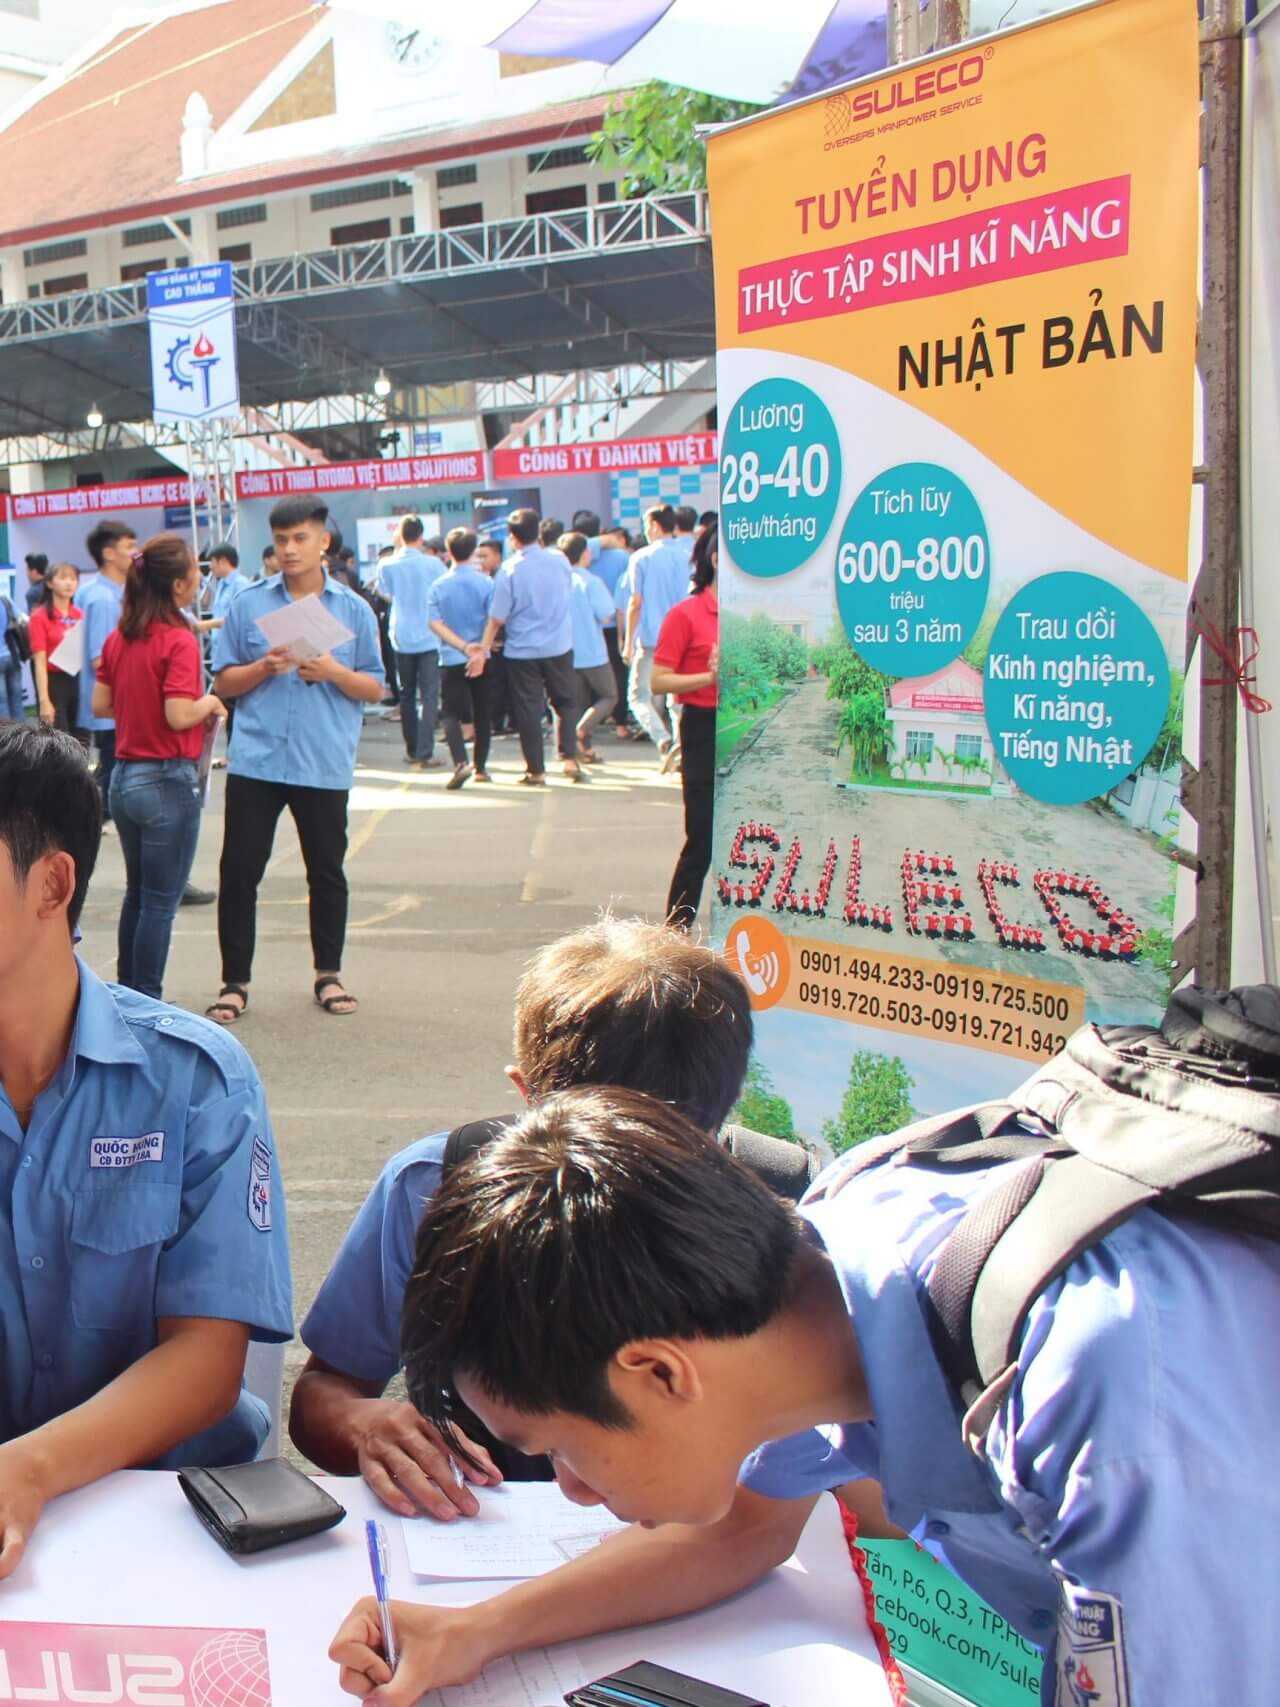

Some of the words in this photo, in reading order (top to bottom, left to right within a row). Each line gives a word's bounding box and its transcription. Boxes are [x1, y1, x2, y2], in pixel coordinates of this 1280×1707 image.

[852, 56, 984, 122] SULECO
[877, 110, 937, 136] MANPOWER
[939, 94, 984, 118] SERVICE
[795, 155, 917, 234] TUYỂN
[932, 132, 1047, 201] DỤNG
[741, 271, 814, 317] THỰC
[823, 253, 874, 304] TẬP
[882, 240, 961, 287] SINH
[968, 218, 998, 267] KĨ
[1009, 200, 1122, 259] NĂNG
[898, 318, 1026, 391] NHẬT
[1042, 288, 1164, 369] BẢN
[739, 401, 804, 433] Lương
[412, 457, 478, 480] SOLUTIONS
[520, 448, 568, 473] CÔNG
[572, 448, 598, 469] TY
[599, 444, 662, 468] DAIKIN
[666, 436, 706, 466] VIỆT
[721, 443, 829, 504] 28-40
[871, 490, 913, 516] Tích
[920, 488, 952, 518] lũy
[728, 514, 816, 542] triệu/tháng
[838, 535, 985, 584] 600-800
[889, 592, 925, 613] triệu
[854, 626, 889, 643] sau
[895, 620, 909, 643] 3
[915, 620, 962, 643] năm
[1016, 612, 1068, 641] Trau
[1075, 607, 1116, 641] dồi
[989, 654, 1036, 682] Kinh
[1042, 658, 1155, 689] nghiệm,
[1013, 694, 1038, 722] Kĩ
[1040, 698, 1112, 729] năng,
[1000, 732, 1058, 767] Tiếng
[1066, 736, 1133, 767] Nhật
[718, 818, 1144, 964] SULECO
[799, 948, 1071, 1022] 0901.494.233-0919.725.500
[798, 981, 1067, 1057] 0919.720.503-0919.721.942
[94, 1138, 129, 1155] QUỐC
[903, 1569, 930, 1605] P.6,
[935, 1589, 974, 1626] Q.3,
